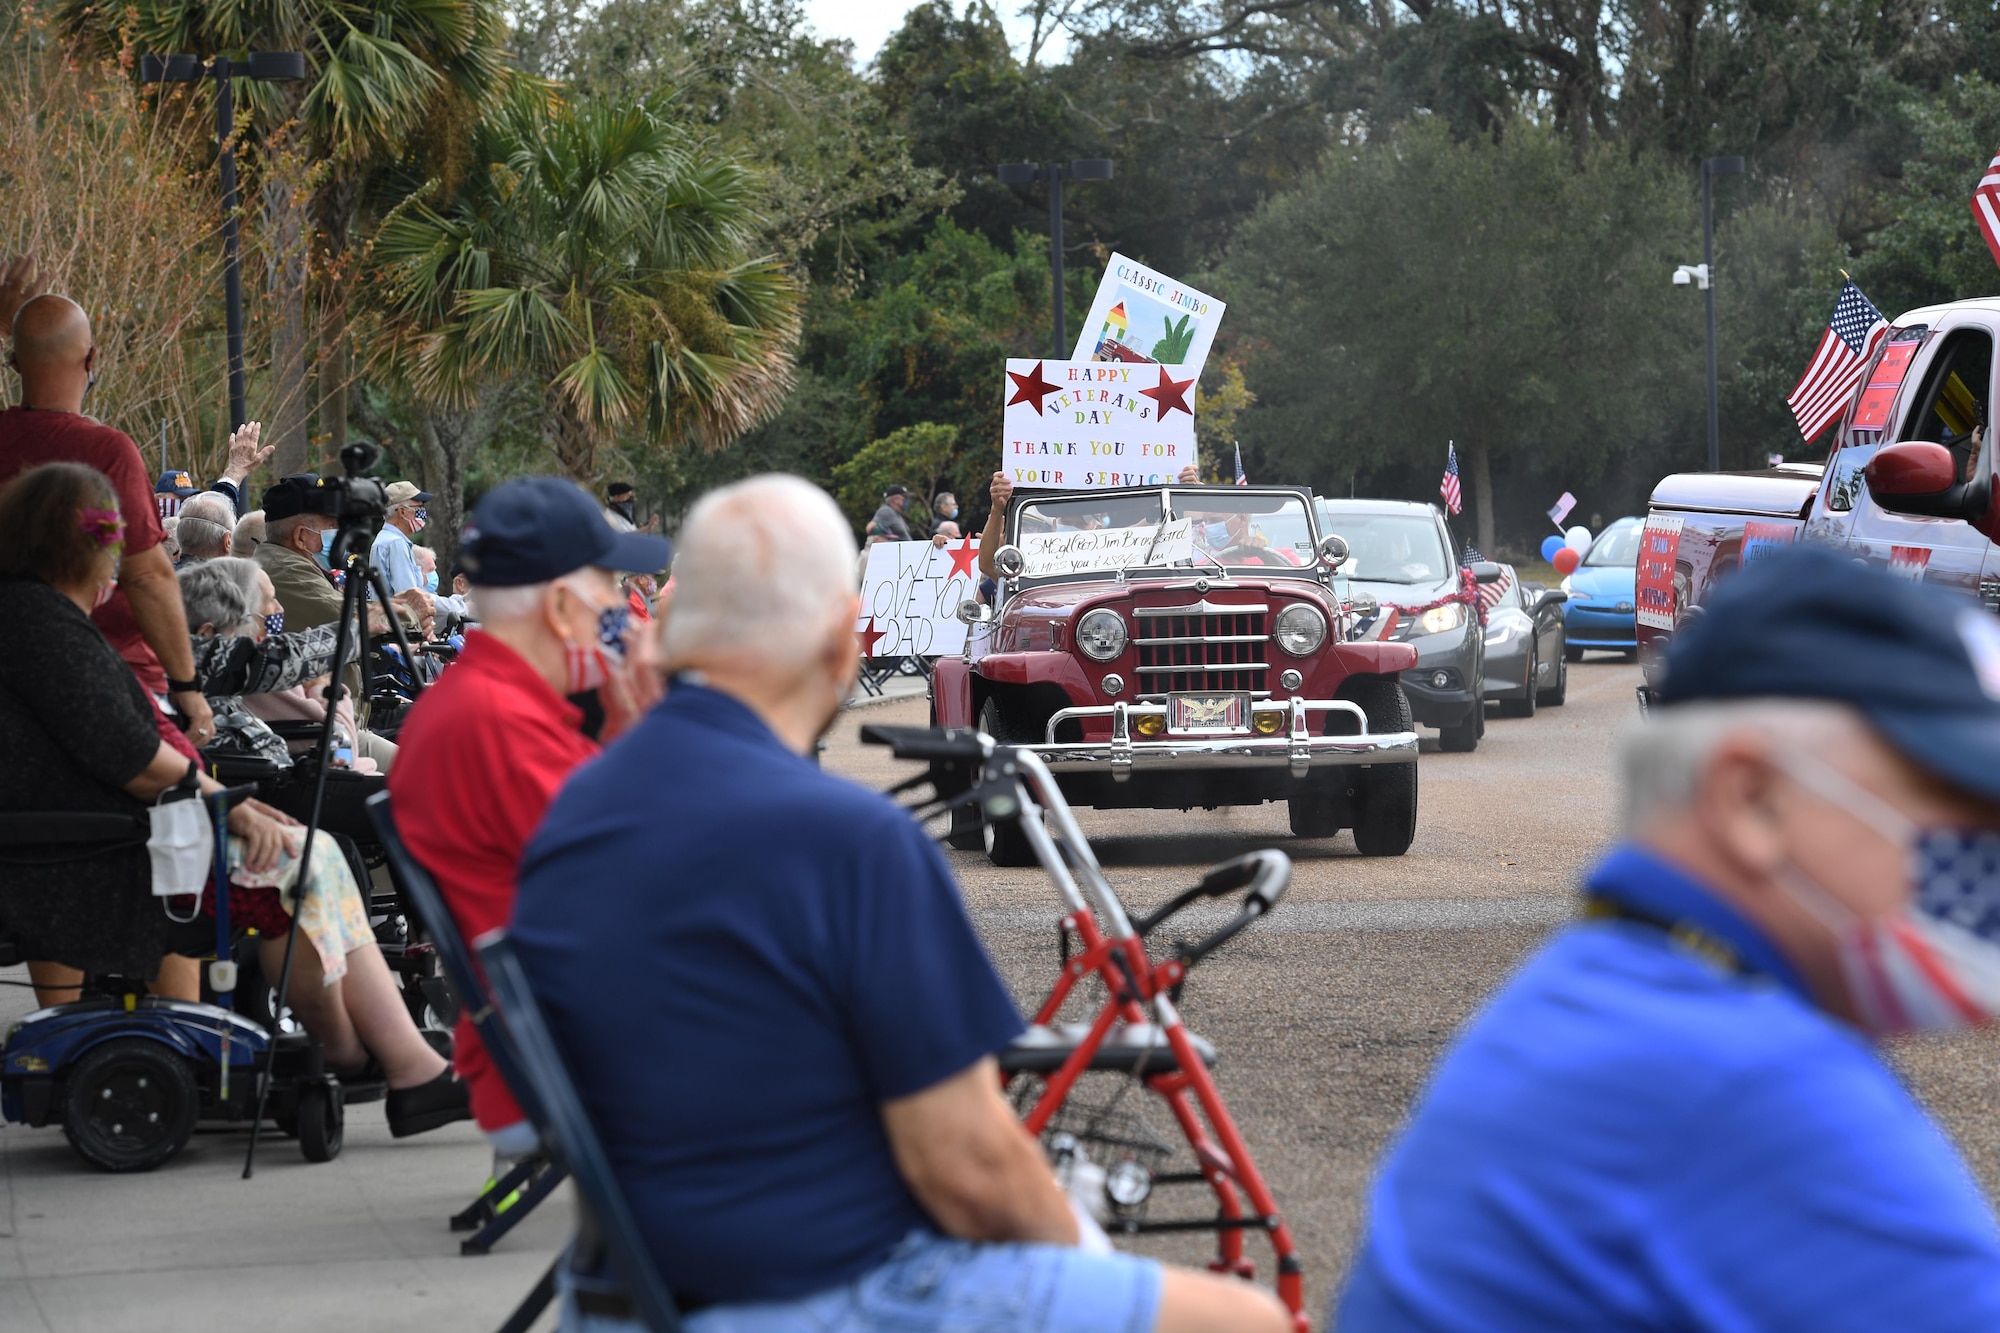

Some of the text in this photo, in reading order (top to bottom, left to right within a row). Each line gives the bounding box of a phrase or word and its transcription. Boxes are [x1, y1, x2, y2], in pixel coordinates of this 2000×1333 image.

[1117, 264, 1208, 316] CLASSIC JIMBO
[1068, 368, 1131, 383] HAPPY
[1047, 389, 1151, 419] VETERANS
[1075, 411, 1113, 425] DAY
[1013, 441, 1176, 457] THANK YOU FOR
[1014, 468, 1174, 486] YOUR SERVICE
[898, 541, 944, 580] WE
[858, 579, 924, 619] LOVE
[881, 617, 934, 656] DAD
